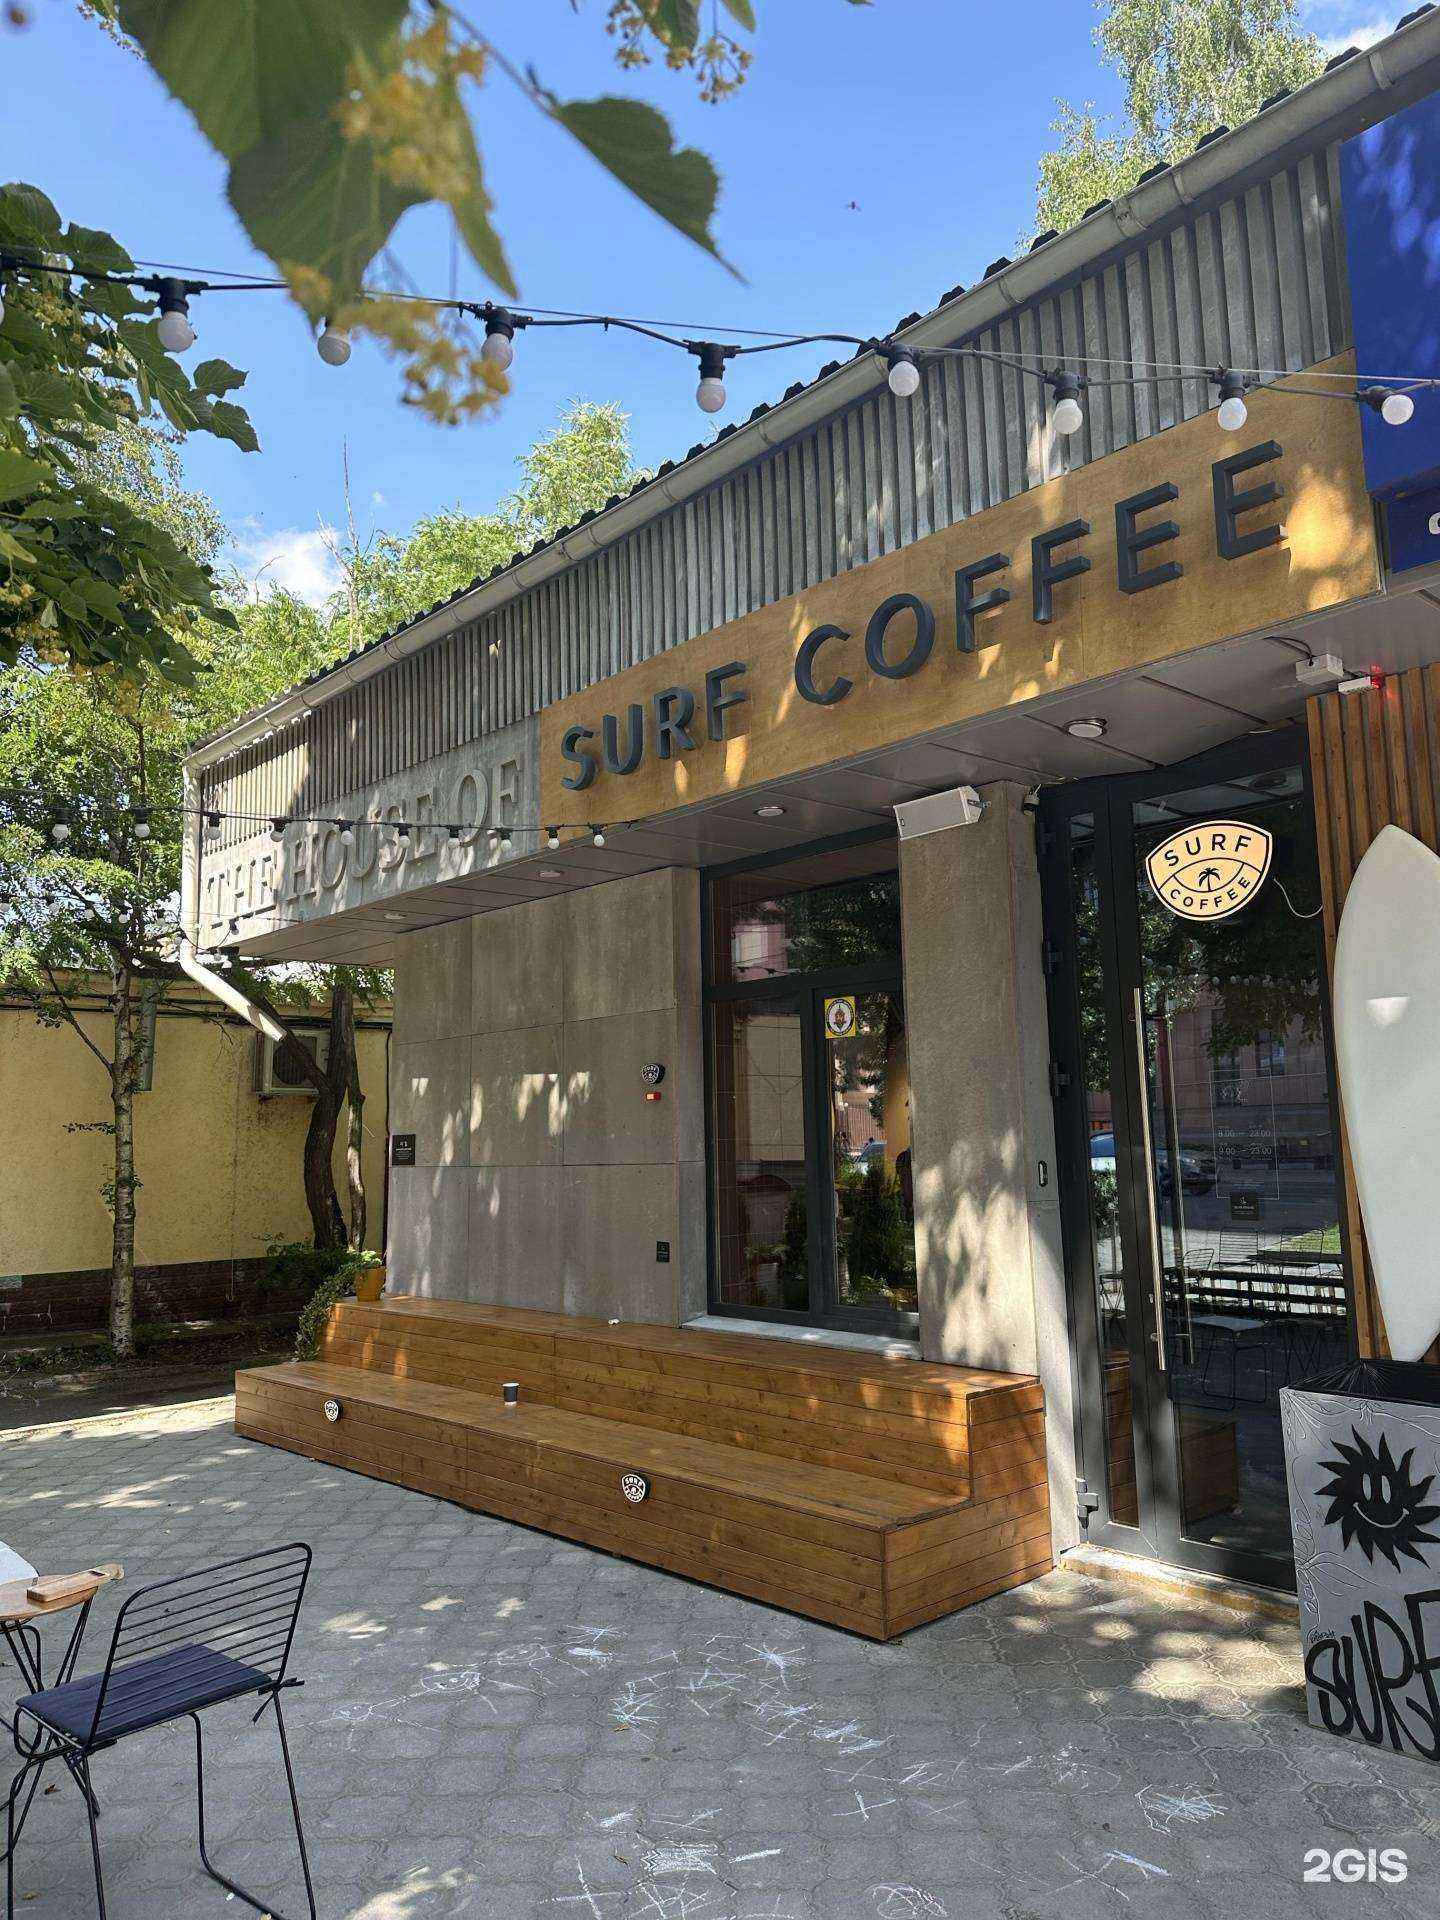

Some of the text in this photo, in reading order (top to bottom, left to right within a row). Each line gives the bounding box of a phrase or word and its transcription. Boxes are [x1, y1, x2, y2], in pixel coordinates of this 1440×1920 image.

[560, 439, 1290, 791] SURF COFFEE
[205, 752, 525, 931] THE HOUSE OF
[1164, 833, 1252, 867] SURF
[1170, 876, 1251, 910] COFFEE
